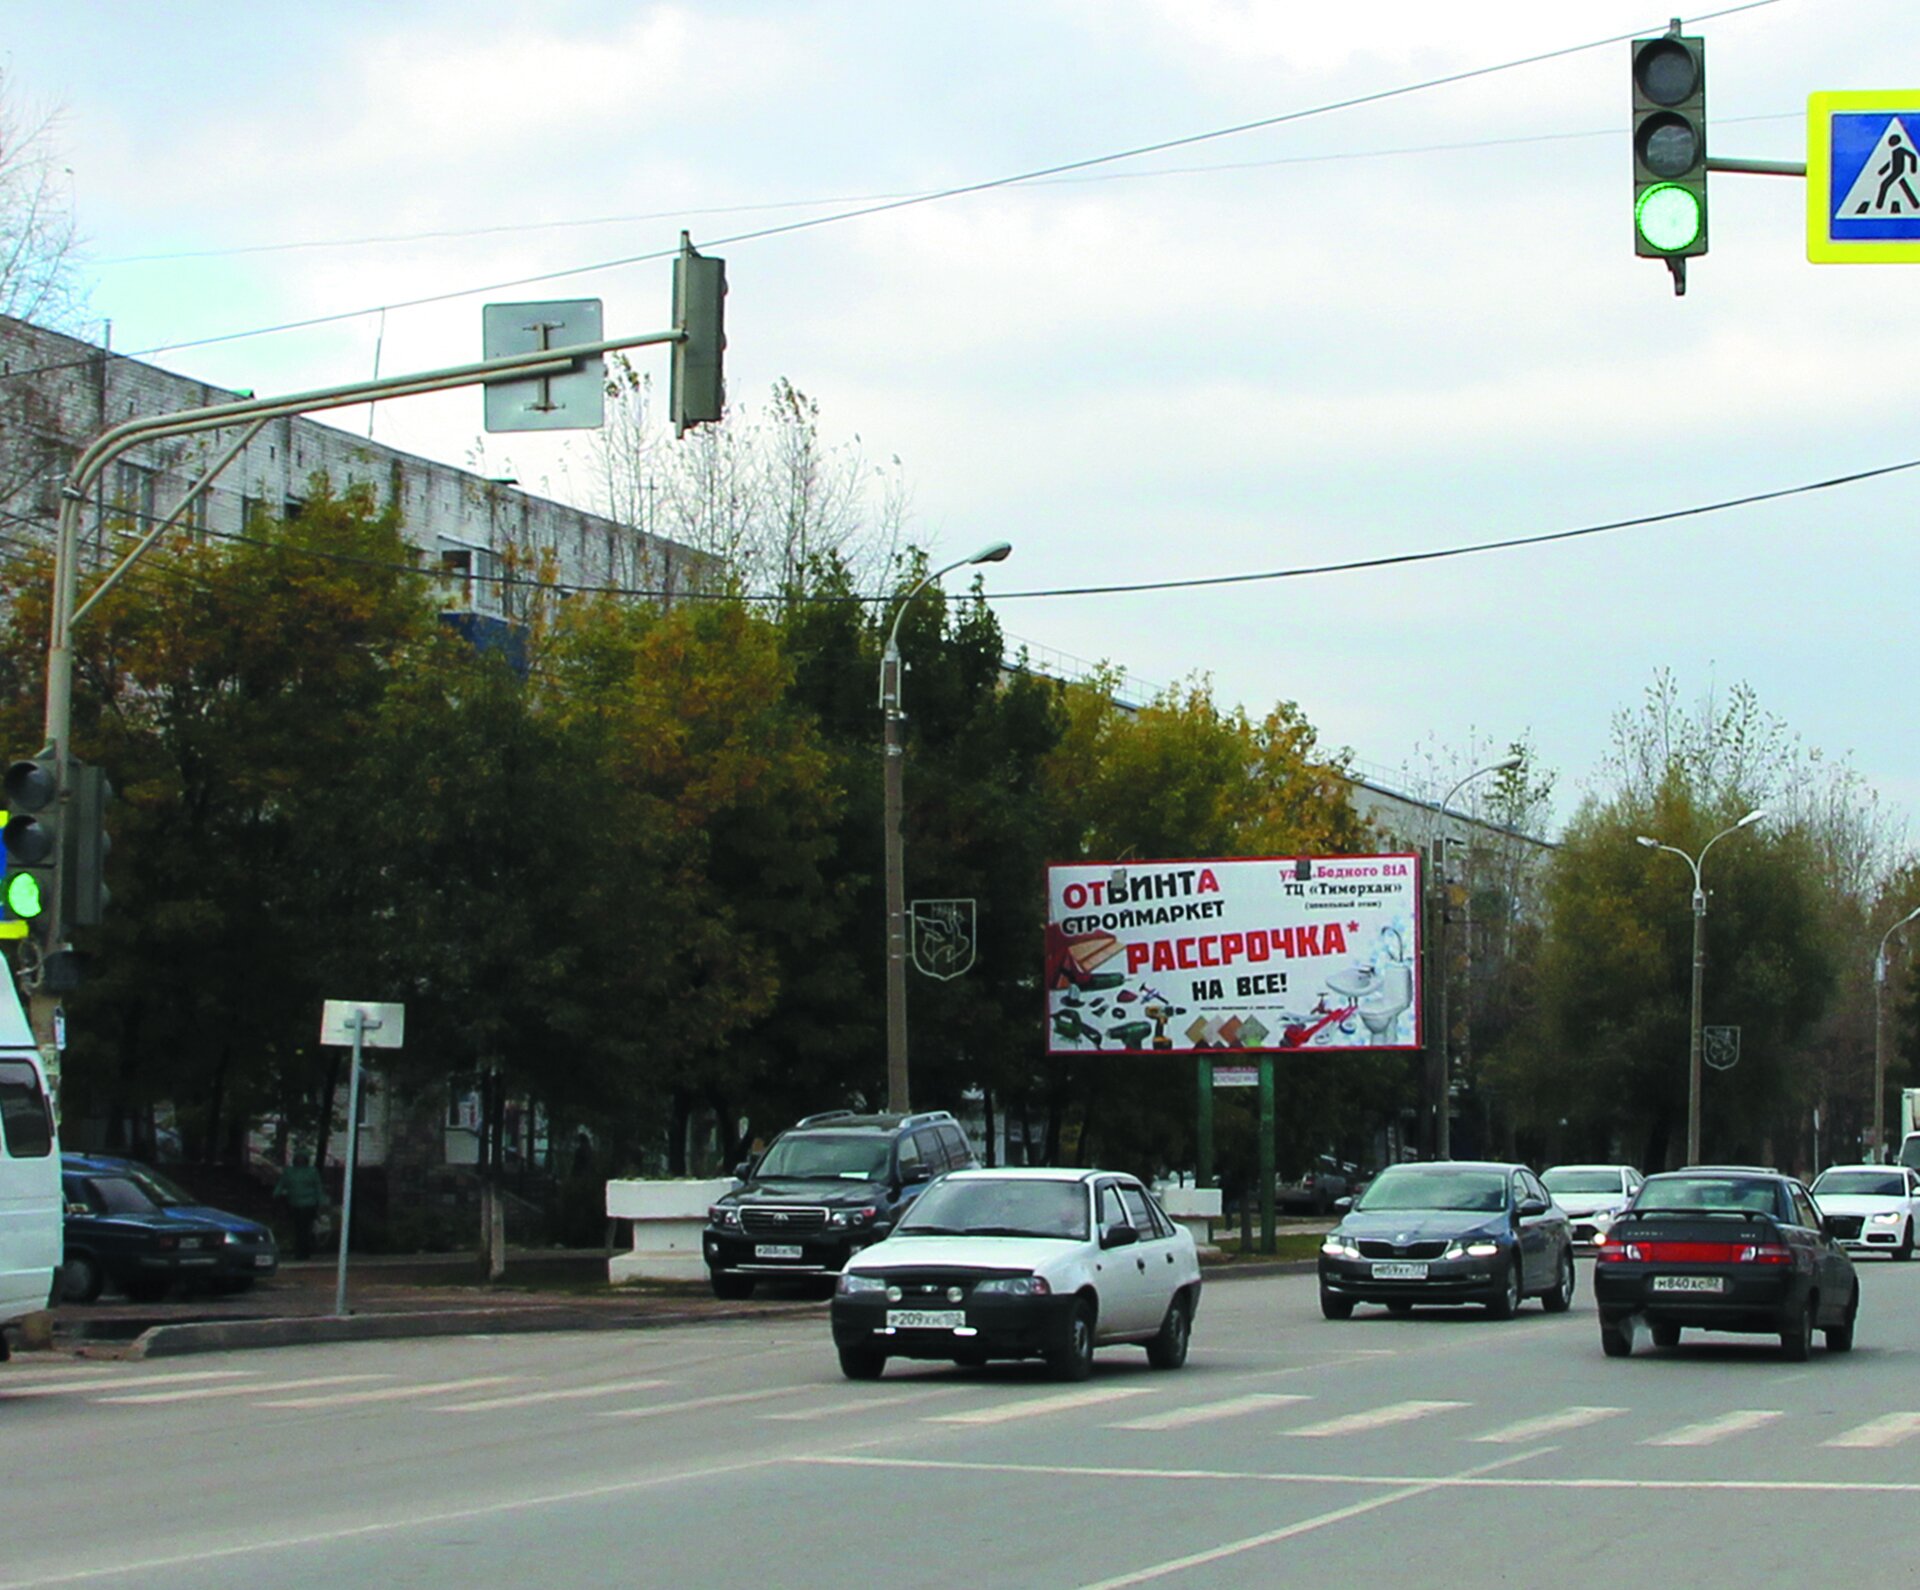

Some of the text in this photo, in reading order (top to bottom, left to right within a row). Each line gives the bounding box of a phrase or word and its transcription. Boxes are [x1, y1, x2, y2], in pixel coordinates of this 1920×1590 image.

[1382, 864, 1408, 877] 81А
[1062, 869, 1220, 910] ОТВИНТА
[1284, 884, 1305, 897] ТЦ
[1062, 900, 1225, 935] СТРОЙМАРКЕТ
[1192, 973, 1288, 1001] НА ВСЕ!
